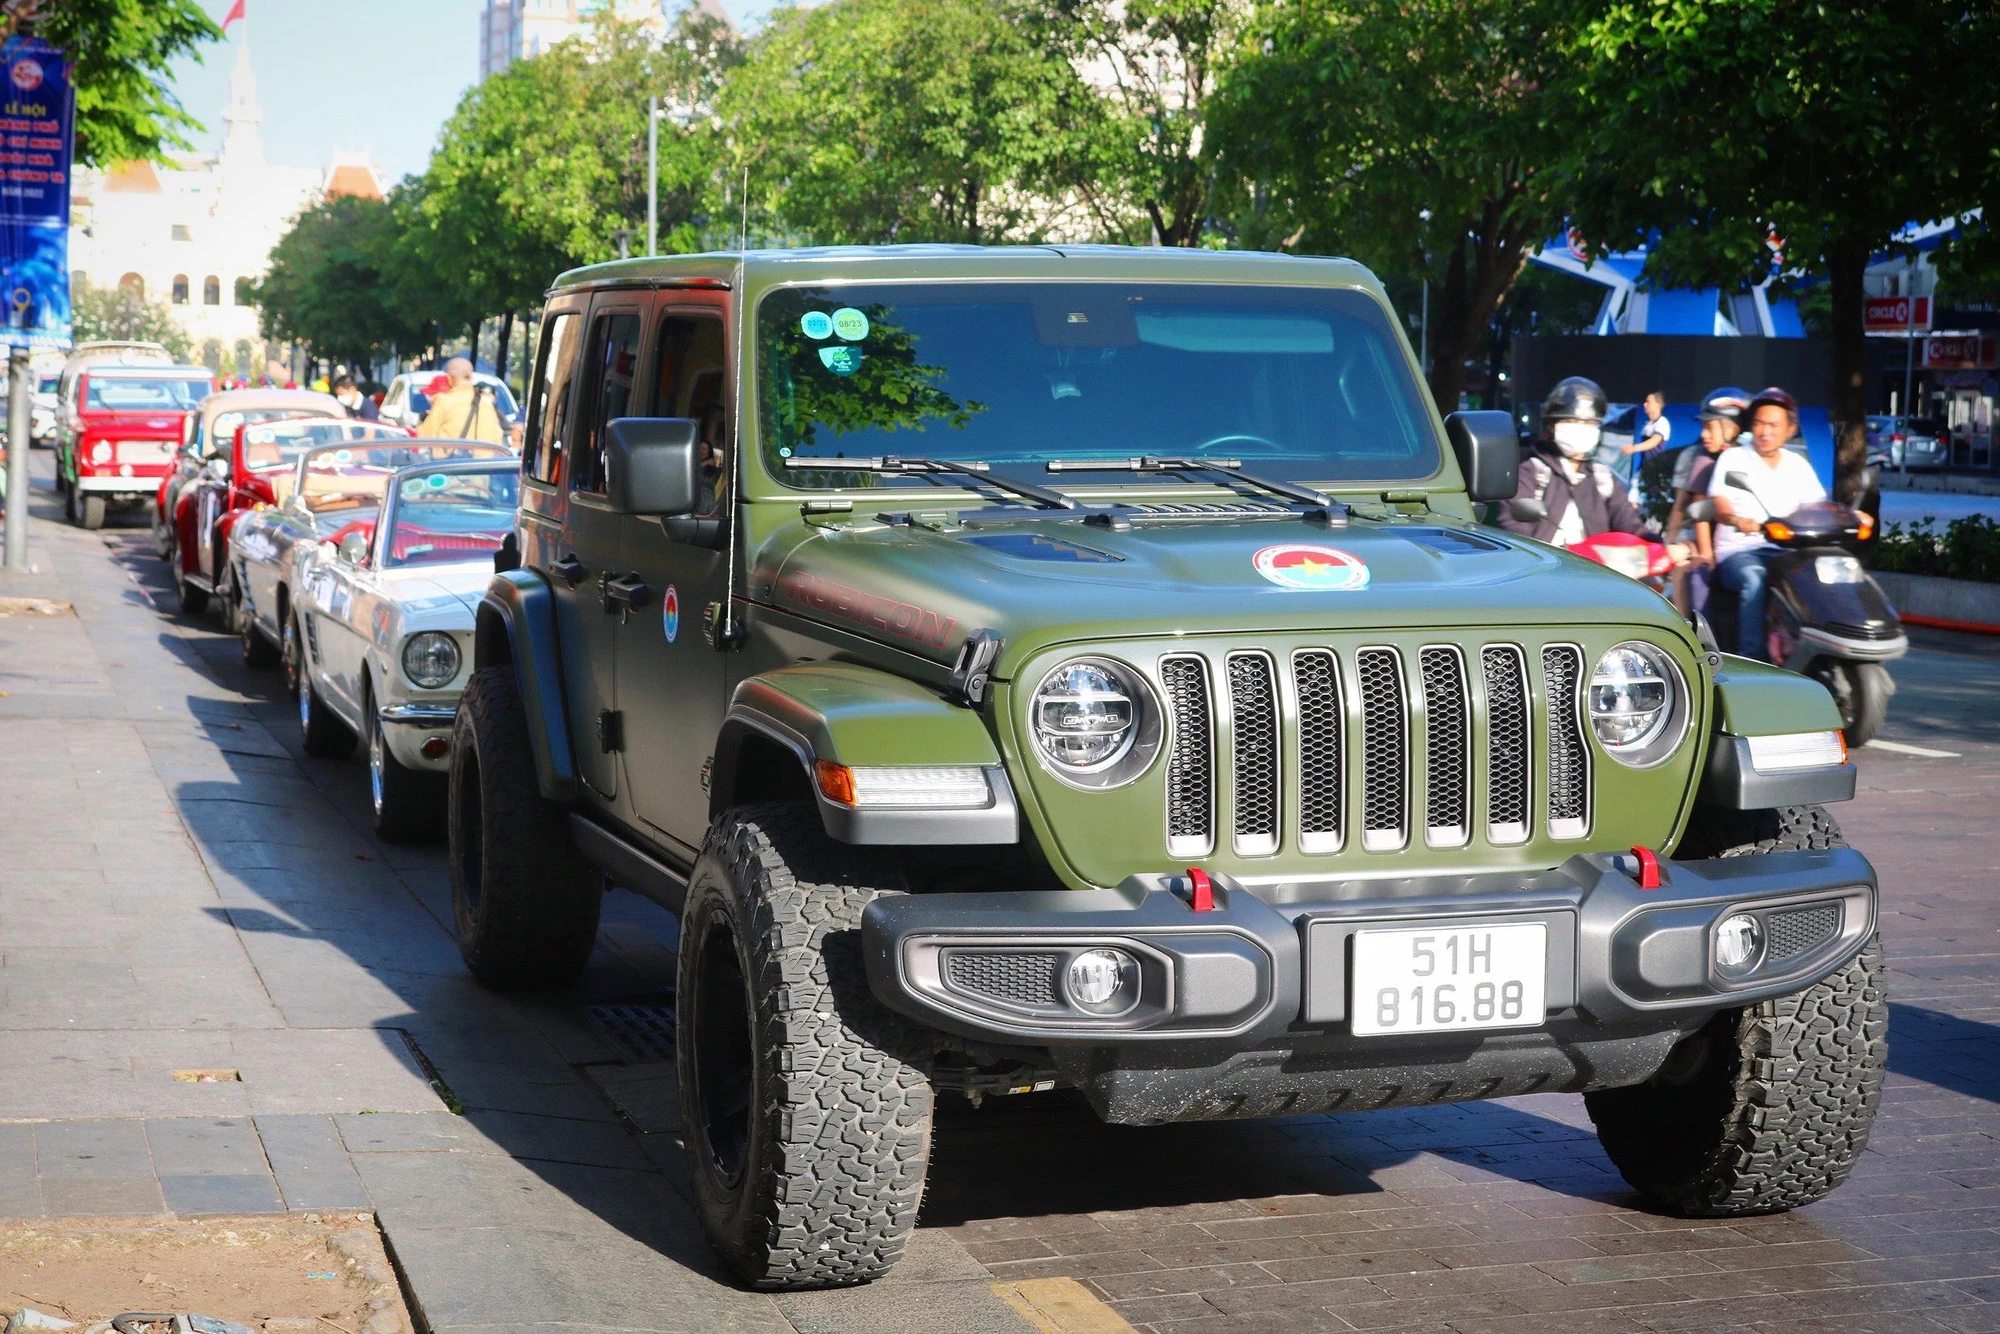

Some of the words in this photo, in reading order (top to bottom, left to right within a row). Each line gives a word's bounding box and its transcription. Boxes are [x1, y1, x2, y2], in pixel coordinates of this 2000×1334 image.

[839, 320, 862, 328] 08/23
[1868, 305, 1896, 319] CIRCLE
[786, 569, 958, 650] RUBICON
[1412, 933, 1492, 977] 51H
[1376, 980, 1523, 1027] 816.88
